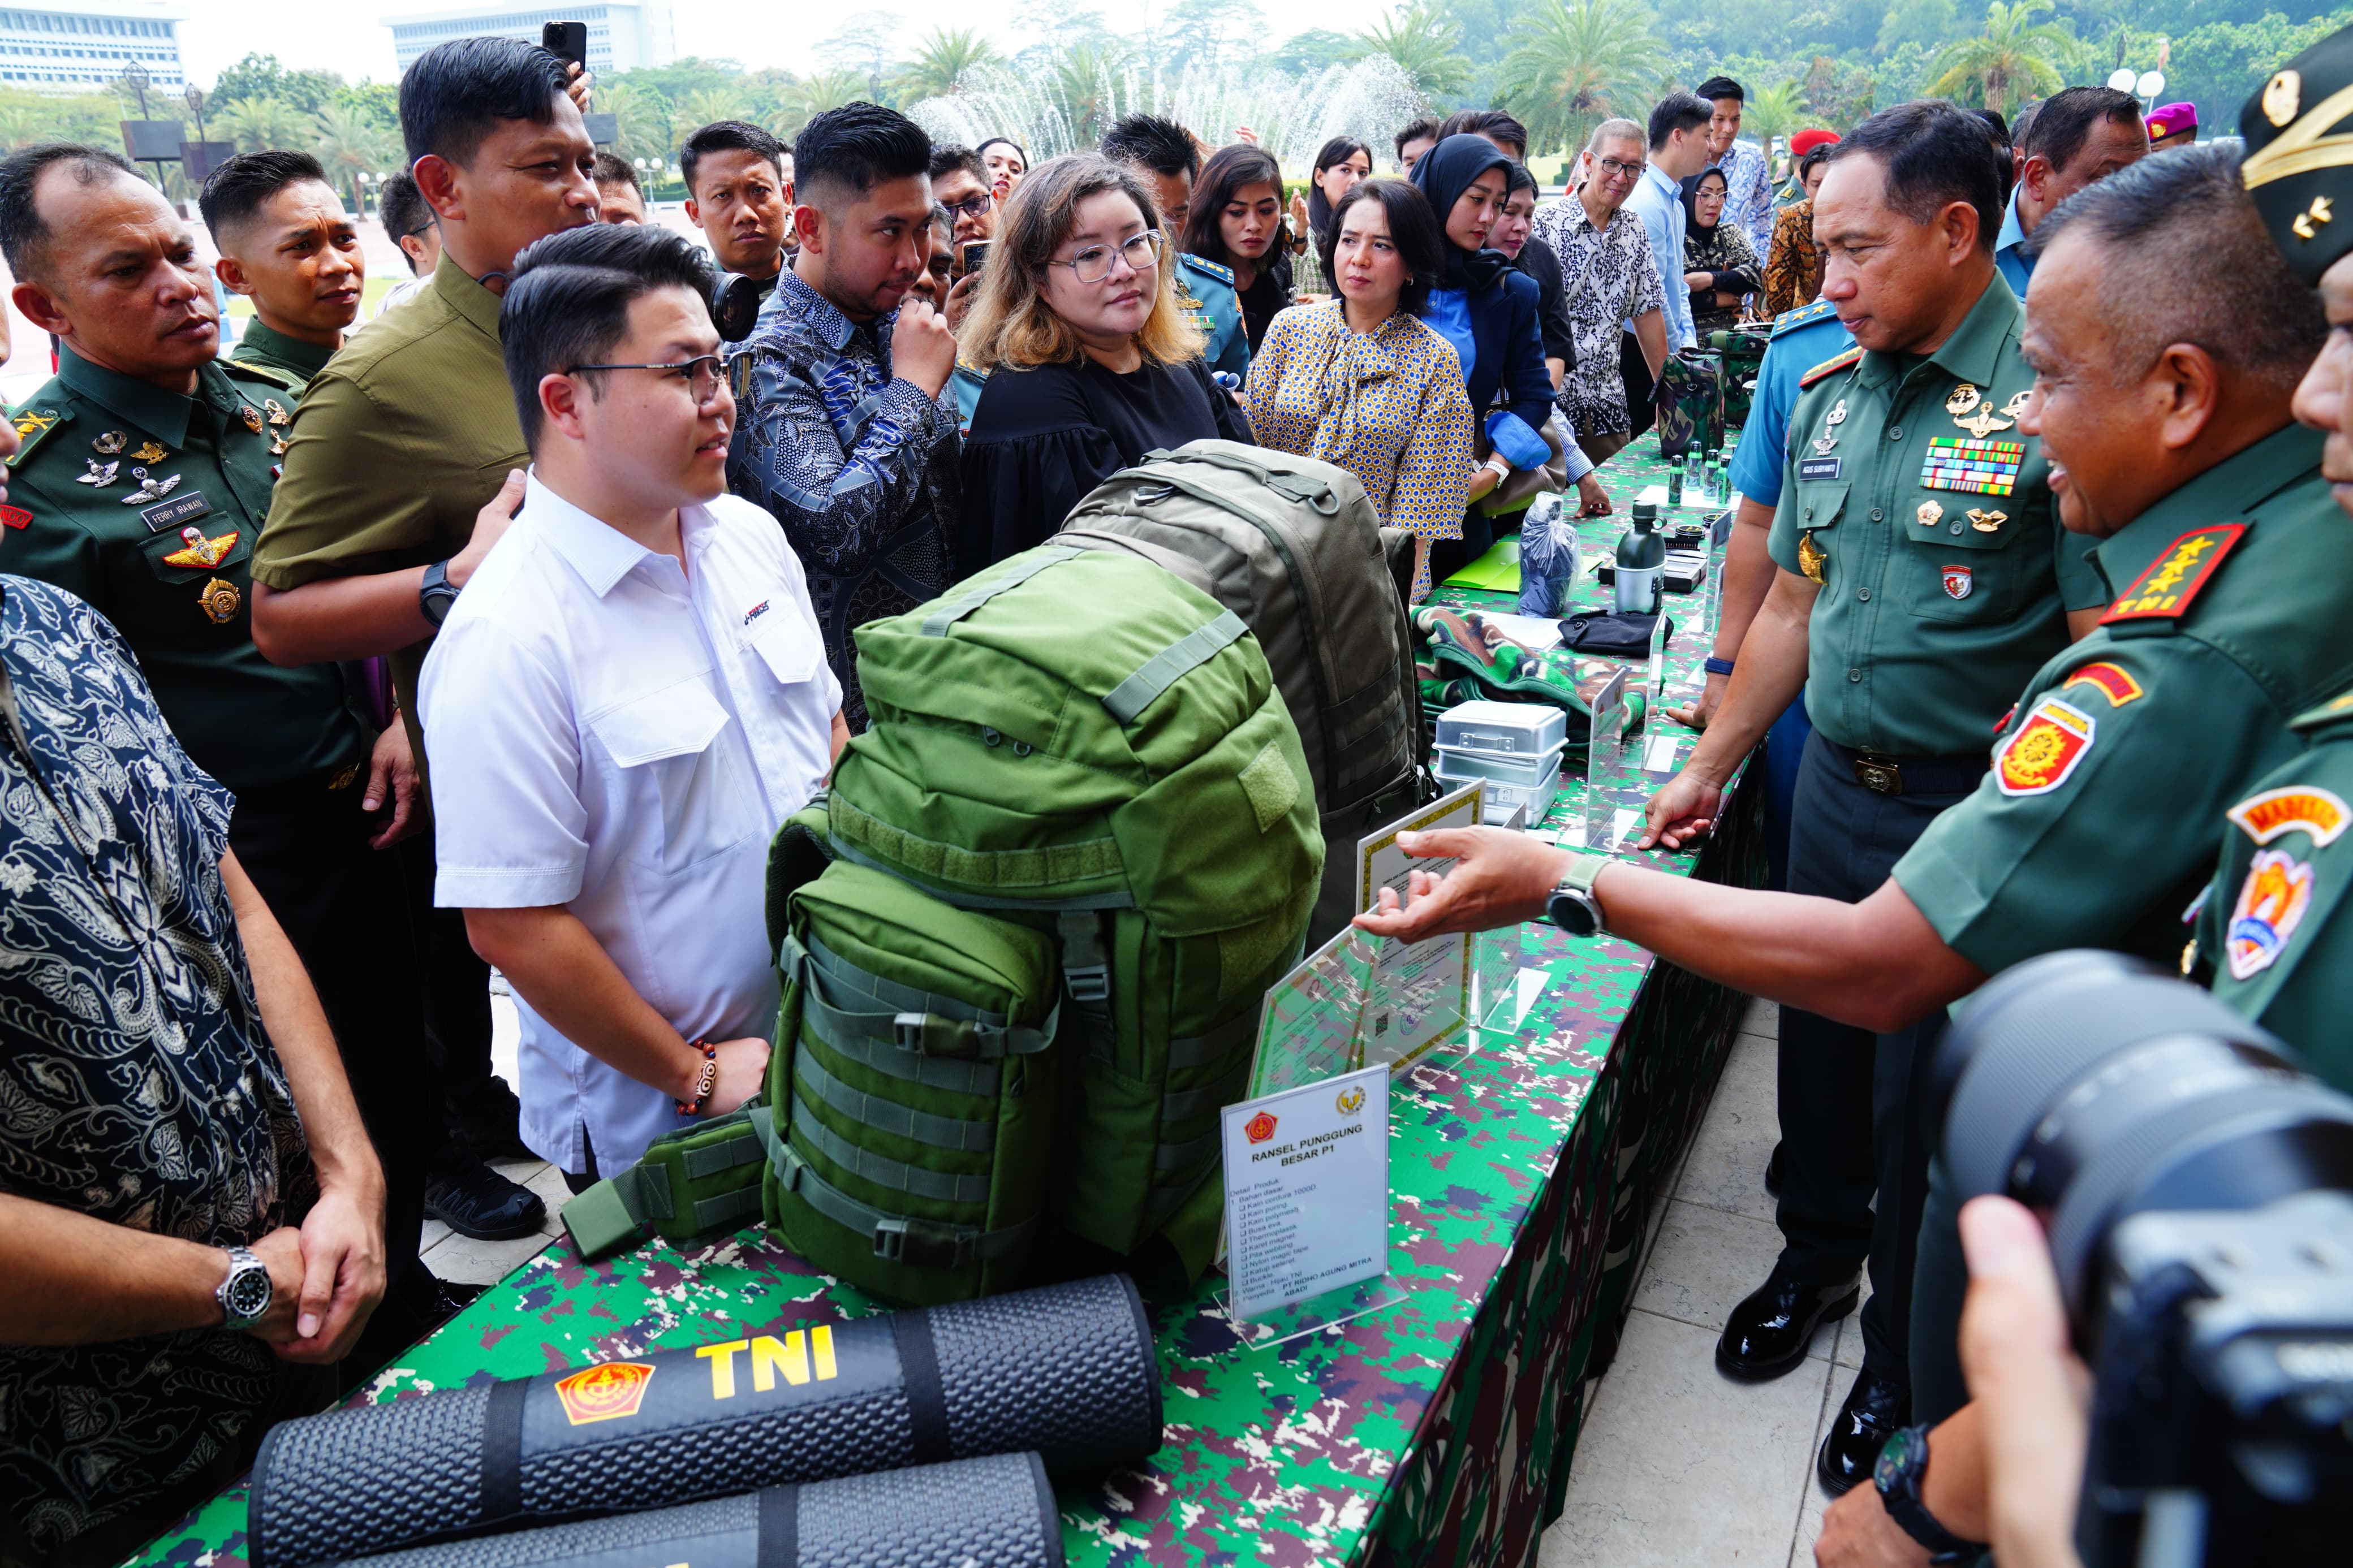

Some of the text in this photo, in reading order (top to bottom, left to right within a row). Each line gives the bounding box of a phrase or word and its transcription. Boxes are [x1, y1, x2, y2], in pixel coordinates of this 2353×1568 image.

[1802, 465, 1813, 474] AGUS
[152, 499, 203, 524] FERRY IRAWAN
[2117, 595, 2178, 614] TNI
[1252, 1124, 1363, 1163] RANSEL PUNGGUNG
[1281, 1144, 1334, 1167] BESAR P1
[1230, 1186, 1251, 1197] Detail
[1239, 1192, 1262, 1203] Bahan
[1265, 1193, 1291, 1204] cordura
[1248, 1208, 1264, 1217] Kain
[1248, 1217, 1264, 1226] Kain
[1248, 1225, 1266, 1234] Busa
[1249, 1241, 1267, 1250] Karet
[1249, 1258, 1269, 1268] Nylon
[1271, 1251, 1291, 1262] magic
[1250, 1266, 1269, 1276] Katup
[1290, 1271, 1302, 1280] TNI
[1294, 1274, 1318, 1286] RIDHO
[1320, 1264, 1347, 1278] AGUNG
[1348, 1256, 1372, 1269] MITRA
[1283, 1285, 1308, 1298] ABADI
[695, 1325, 837, 1400] TNI
